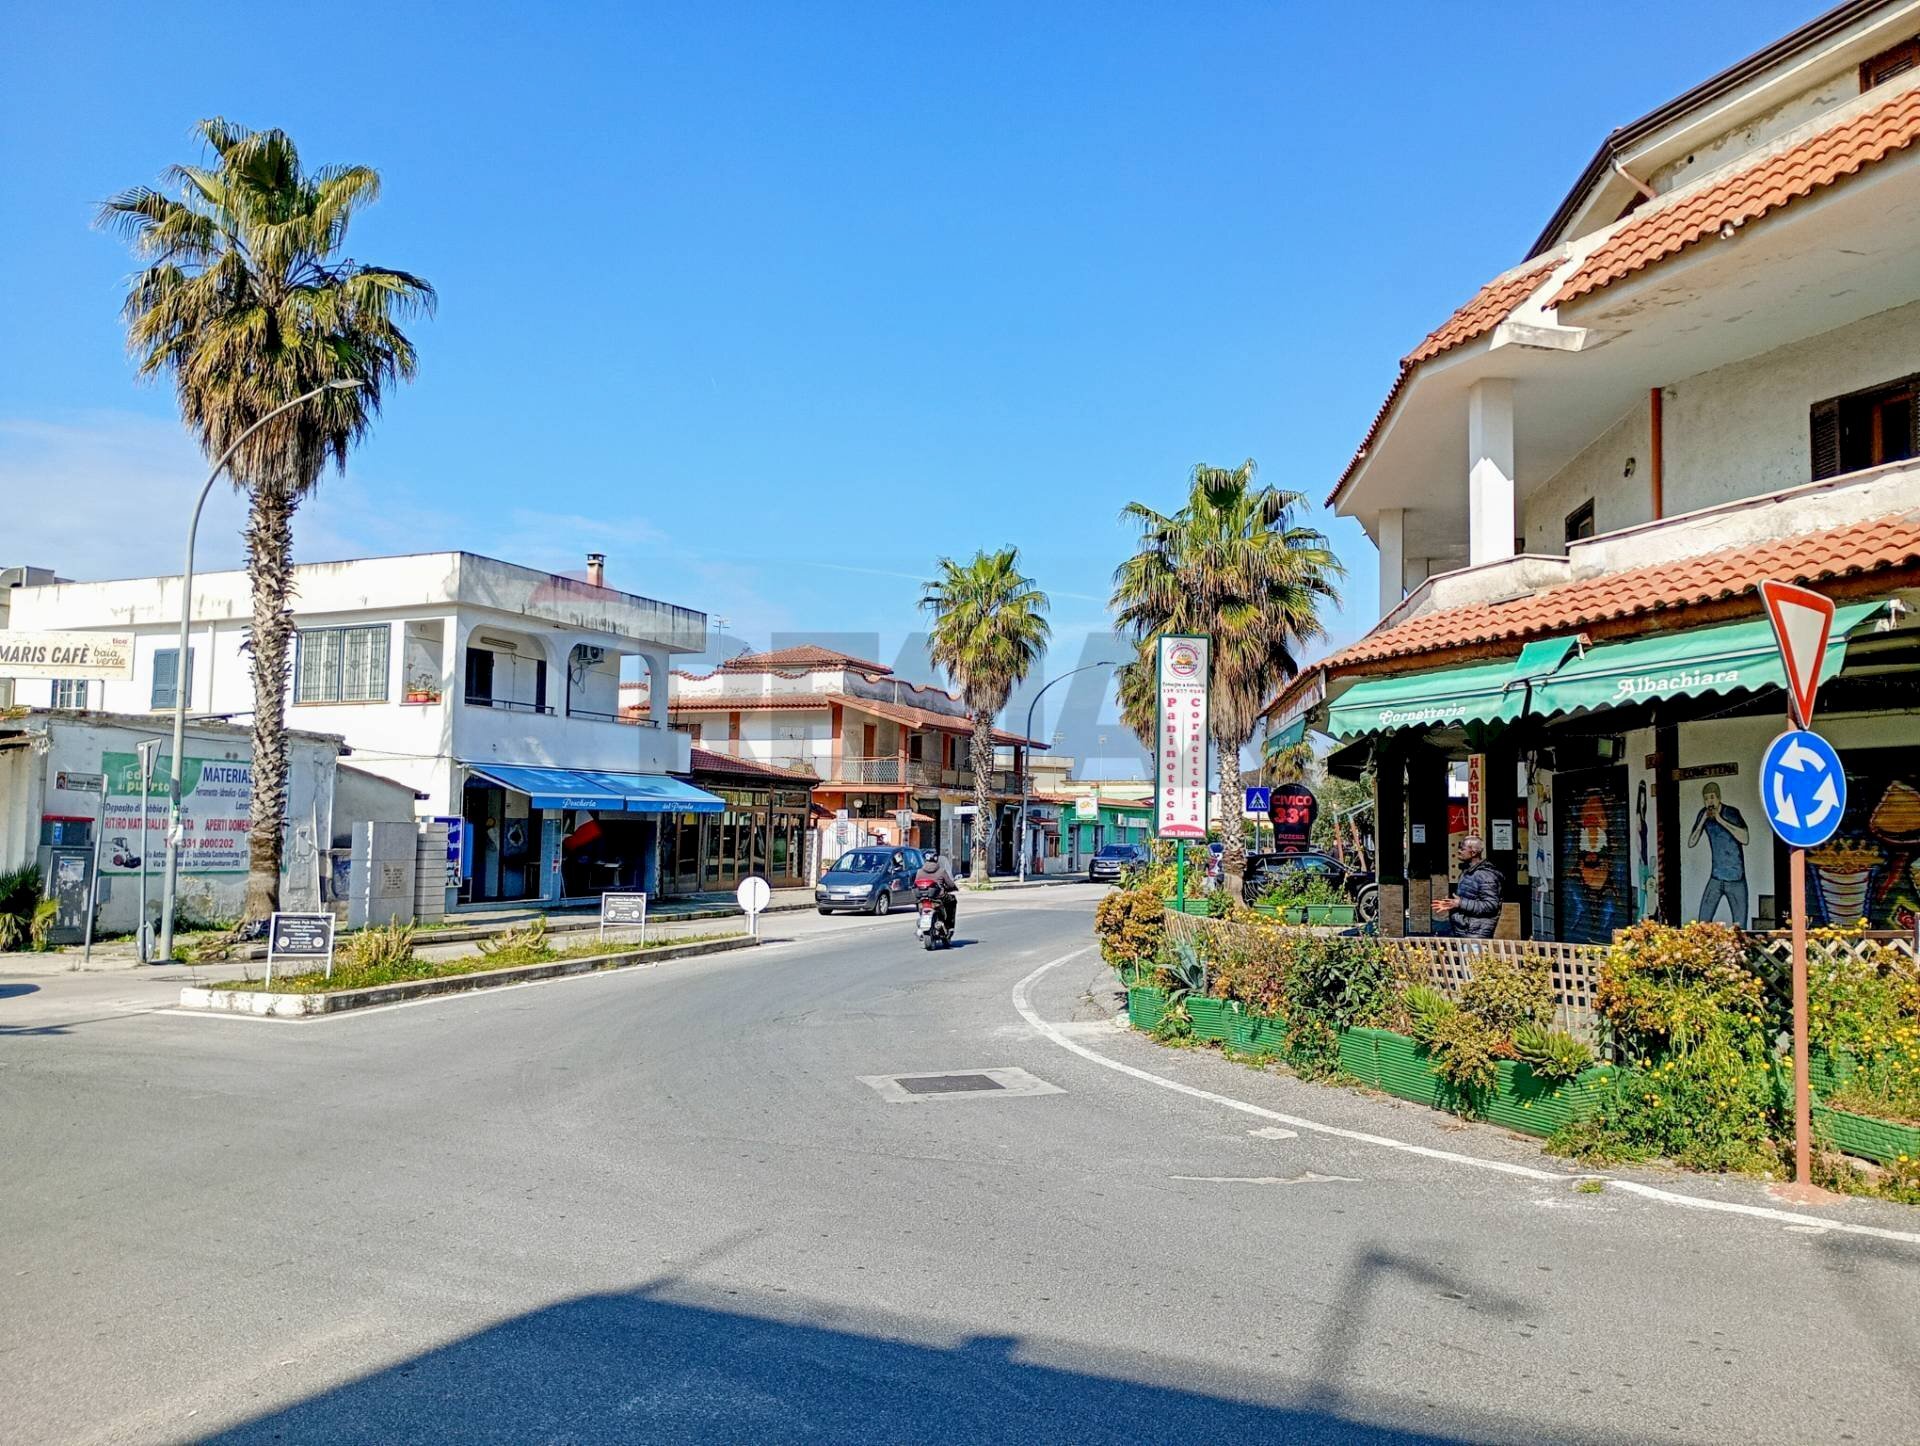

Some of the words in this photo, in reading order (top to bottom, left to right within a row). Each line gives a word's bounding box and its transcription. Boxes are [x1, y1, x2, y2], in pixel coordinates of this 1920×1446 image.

[0, 645, 46, 663] MARIS
[52, 643, 90, 664] CAFÈ
[1611, 669, 1739, 700] Albachiara
[1379, 702, 1466, 725] Cornetteria
[1166, 697, 1177, 821] Paninoteca
[1190, 698, 1201, 822] Cornetteria
[562, 798, 597, 808] Pescheria
[1272, 795, 1312, 805] CIVICO
[105, 803, 133, 814] Deposito
[1274, 808, 1309, 823] 331
[105, 818, 126, 829] RITIRO
[205, 819, 227, 831] APERTI
